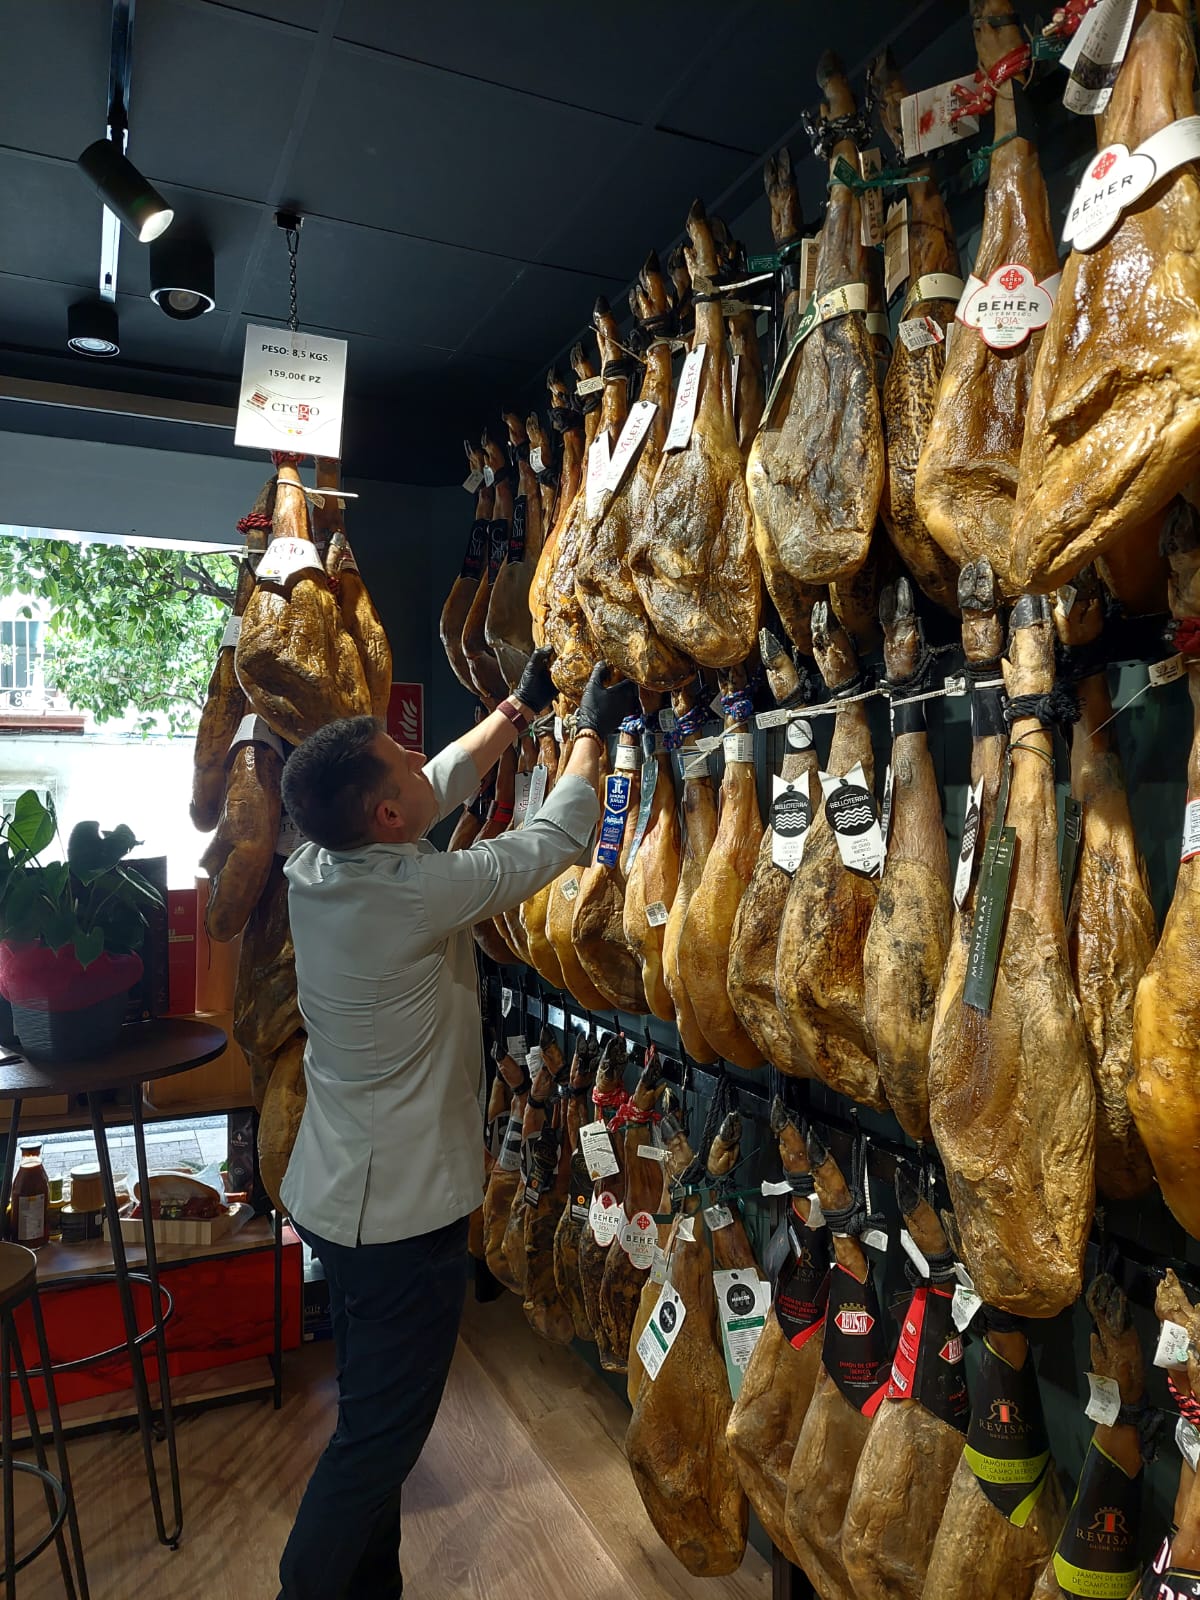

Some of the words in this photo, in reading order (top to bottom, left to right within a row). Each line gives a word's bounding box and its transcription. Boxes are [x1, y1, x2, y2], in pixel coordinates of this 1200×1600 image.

[1072, 174, 1133, 221] BEHER
[978, 300, 1040, 312] BEHER
[261, 344, 289, 355] PESO:
[292, 349, 306, 358] 8,5
[309, 351, 331, 362] KGS.
[268, 369, 306, 382] 159,00€
[308, 375, 322, 384] PZ
[679, 363, 697, 408] VELETA
[829, 794, 869, 809] BELLOTERRA
[971, 895, 988, 978] MONTARAZ
[593, 1213, 619, 1224] BEHER
[841, 1312, 868, 1333] REVISAN
[979, 1418, 1033, 1434] REVISAN
